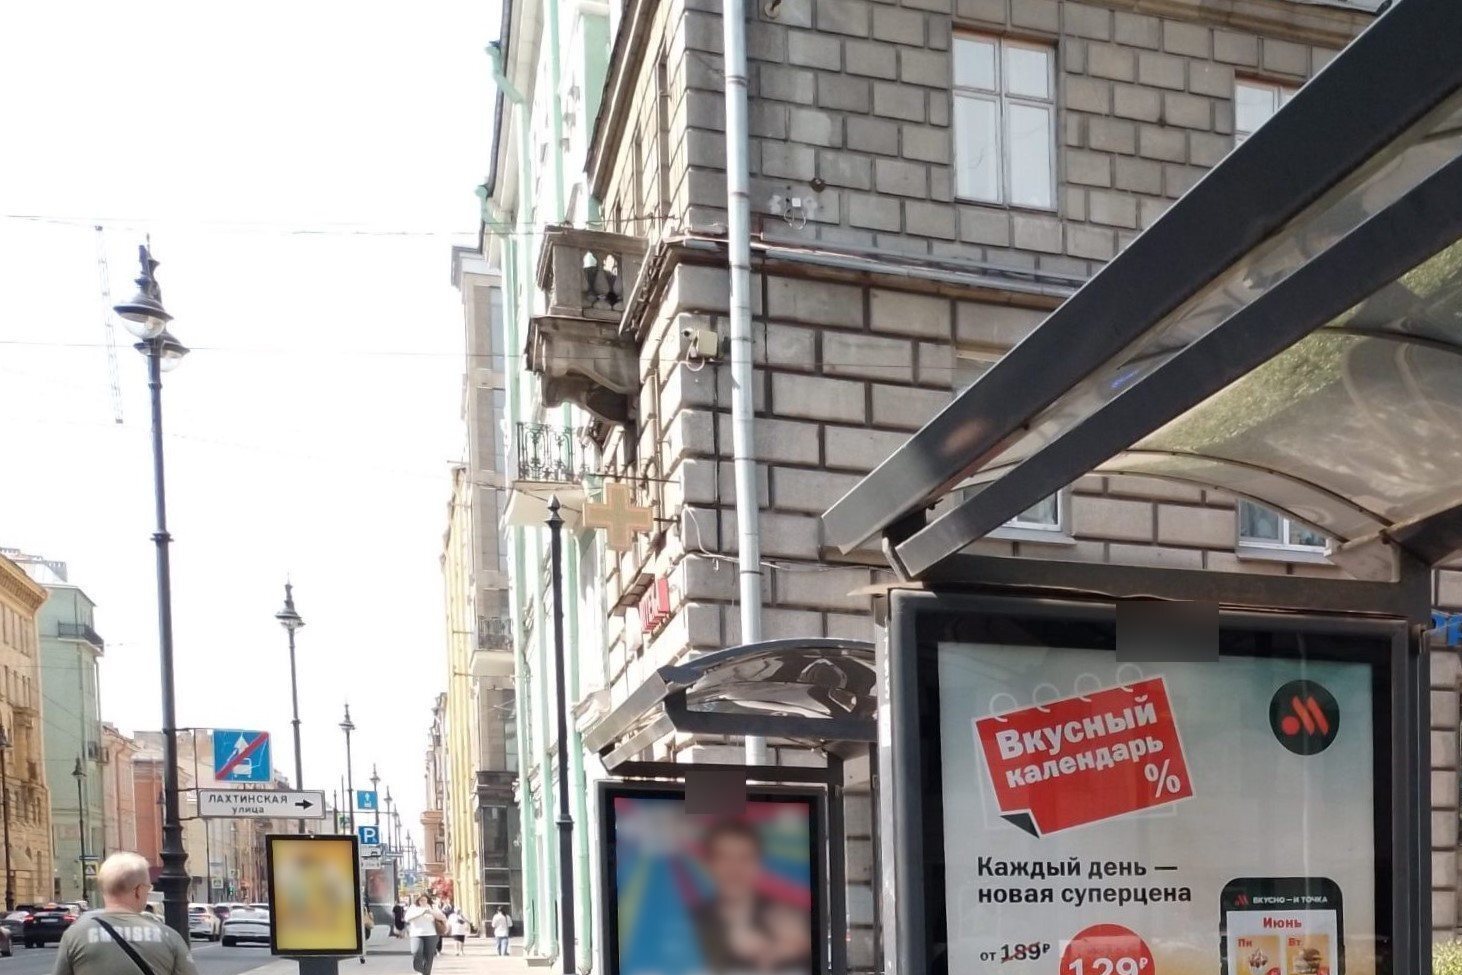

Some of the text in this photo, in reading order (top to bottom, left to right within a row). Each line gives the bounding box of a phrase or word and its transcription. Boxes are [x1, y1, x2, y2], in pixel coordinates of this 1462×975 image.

[996, 694, 1158, 761] Вкусный
[1006, 736, 1164, 788] календарь
[1144, 758, 1181, 798] %
[208, 794, 288, 804] ЛАХТИНСКАЯ
[232, 806, 265, 815] улица
[364, 827, 375, 843] P
[977, 856, 1081, 879] Каждый
[1088, 860, 1147, 879] день
[978, 886, 1192, 907] новая суперцена
[1252, 896, 1285, 904] ВКУСНО
[1301, 895, 1328, 903] ТОЧКА
[1263, 917, 1302, 929] Июнь
[1238, 938, 1253, 948] Пн
[1288, 938, 1301, 946] Вт
[980, 950, 996, 961] от
